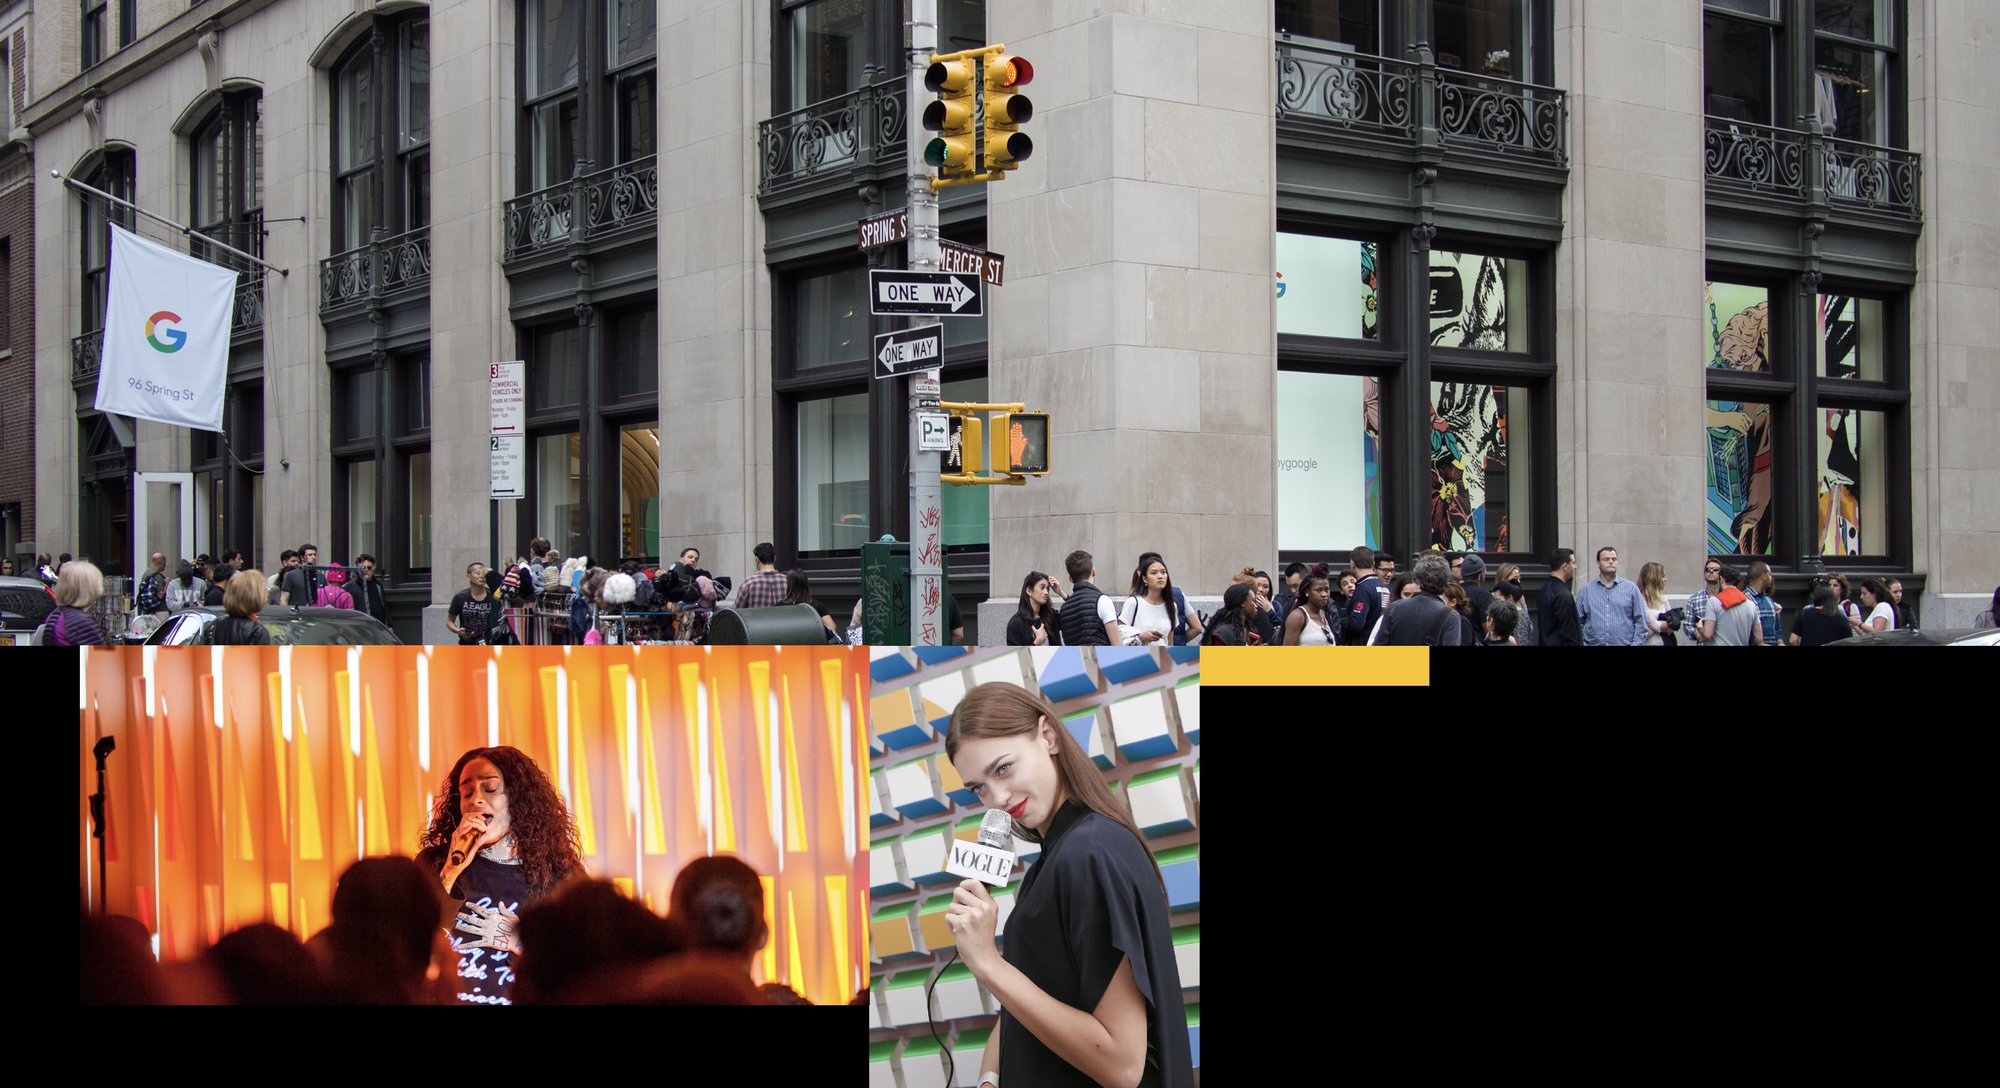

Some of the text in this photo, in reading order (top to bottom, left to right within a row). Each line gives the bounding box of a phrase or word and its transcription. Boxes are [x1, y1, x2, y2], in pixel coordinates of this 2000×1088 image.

[861, 217, 895, 248] SPRING
[900, 214, 908, 239] S
[939, 246, 983, 273] MERCER
[987, 258, 1001, 283] ST
[888, 284, 965, 302] ONE WAY
[145, 310, 187, 354] G
[885, 339, 934, 363] ONE WAY
[491, 364, 498, 378] 3
[128, 377, 195, 401] 96 Spring St
[492, 381, 519, 389] COMMERCIAL
[491, 437, 498, 450] 2
[955, 846, 1011, 878] VOGUE
